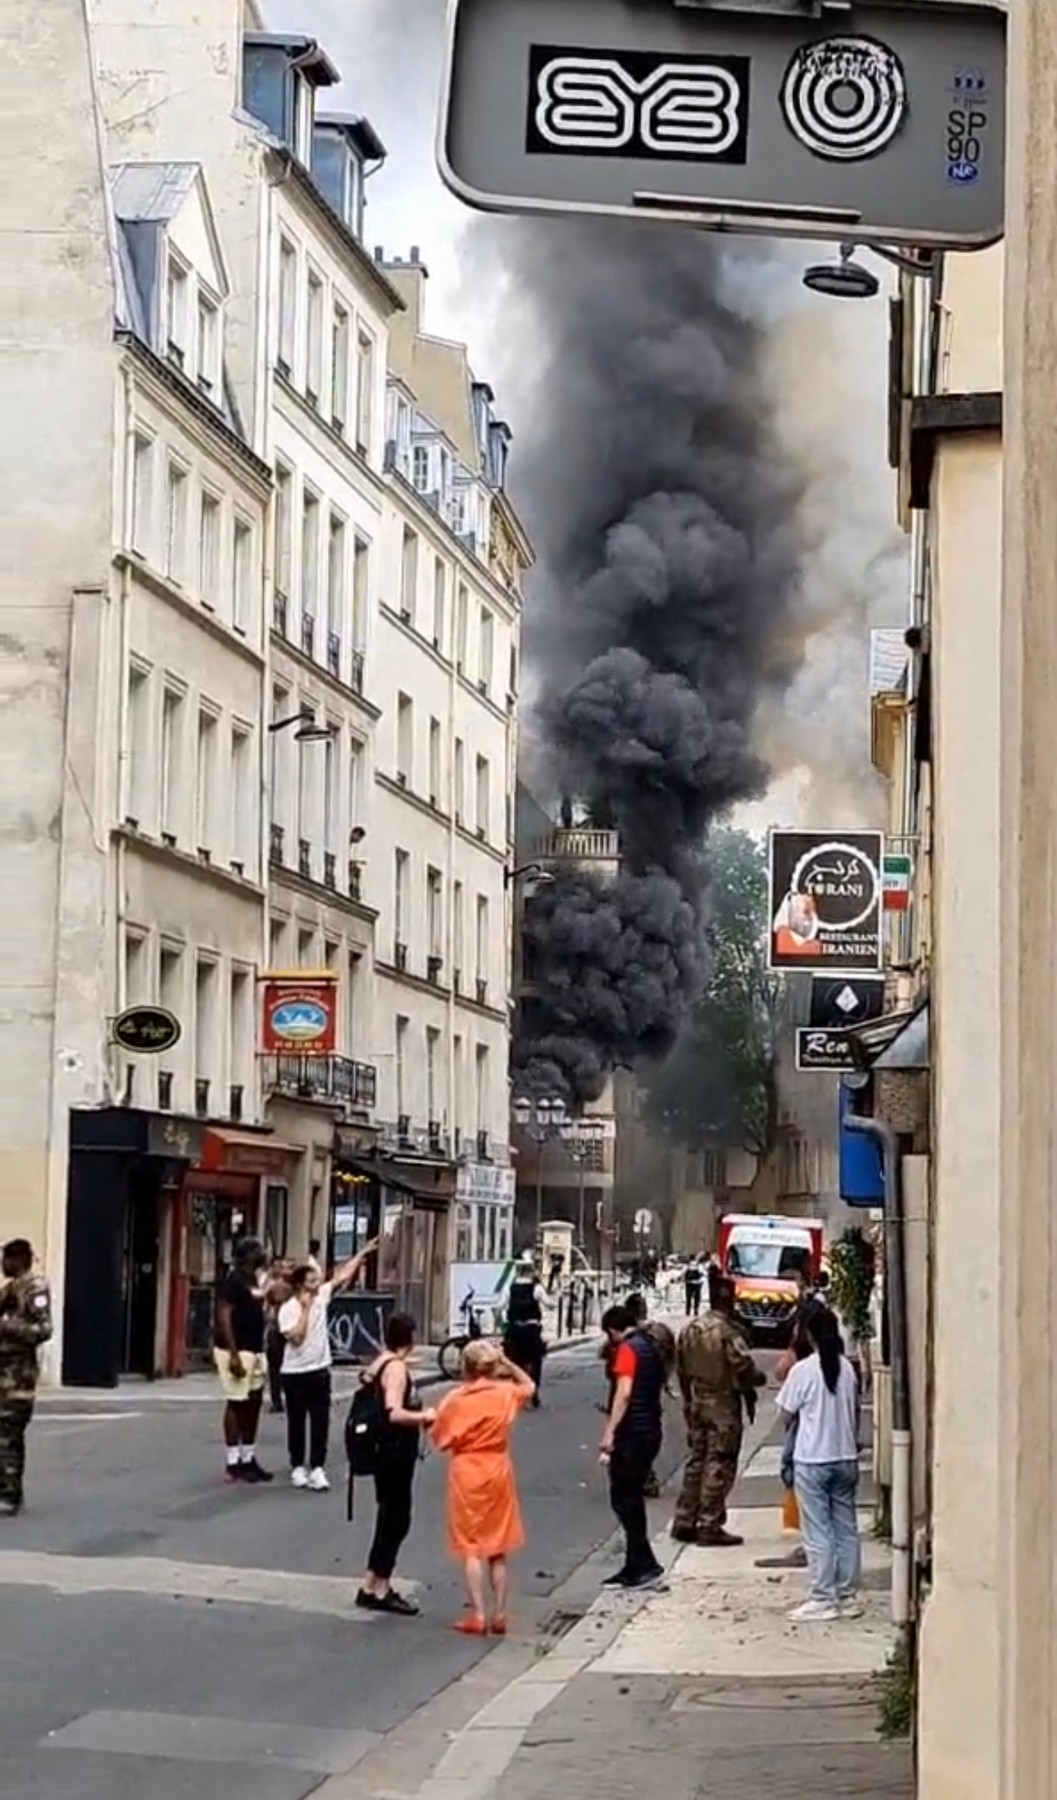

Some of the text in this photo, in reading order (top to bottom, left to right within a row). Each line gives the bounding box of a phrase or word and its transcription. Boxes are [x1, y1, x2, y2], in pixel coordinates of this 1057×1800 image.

[947, 110, 987, 136] SP
[947, 137, 980, 162] 90
[822, 943, 878, 955] IRANIEN
